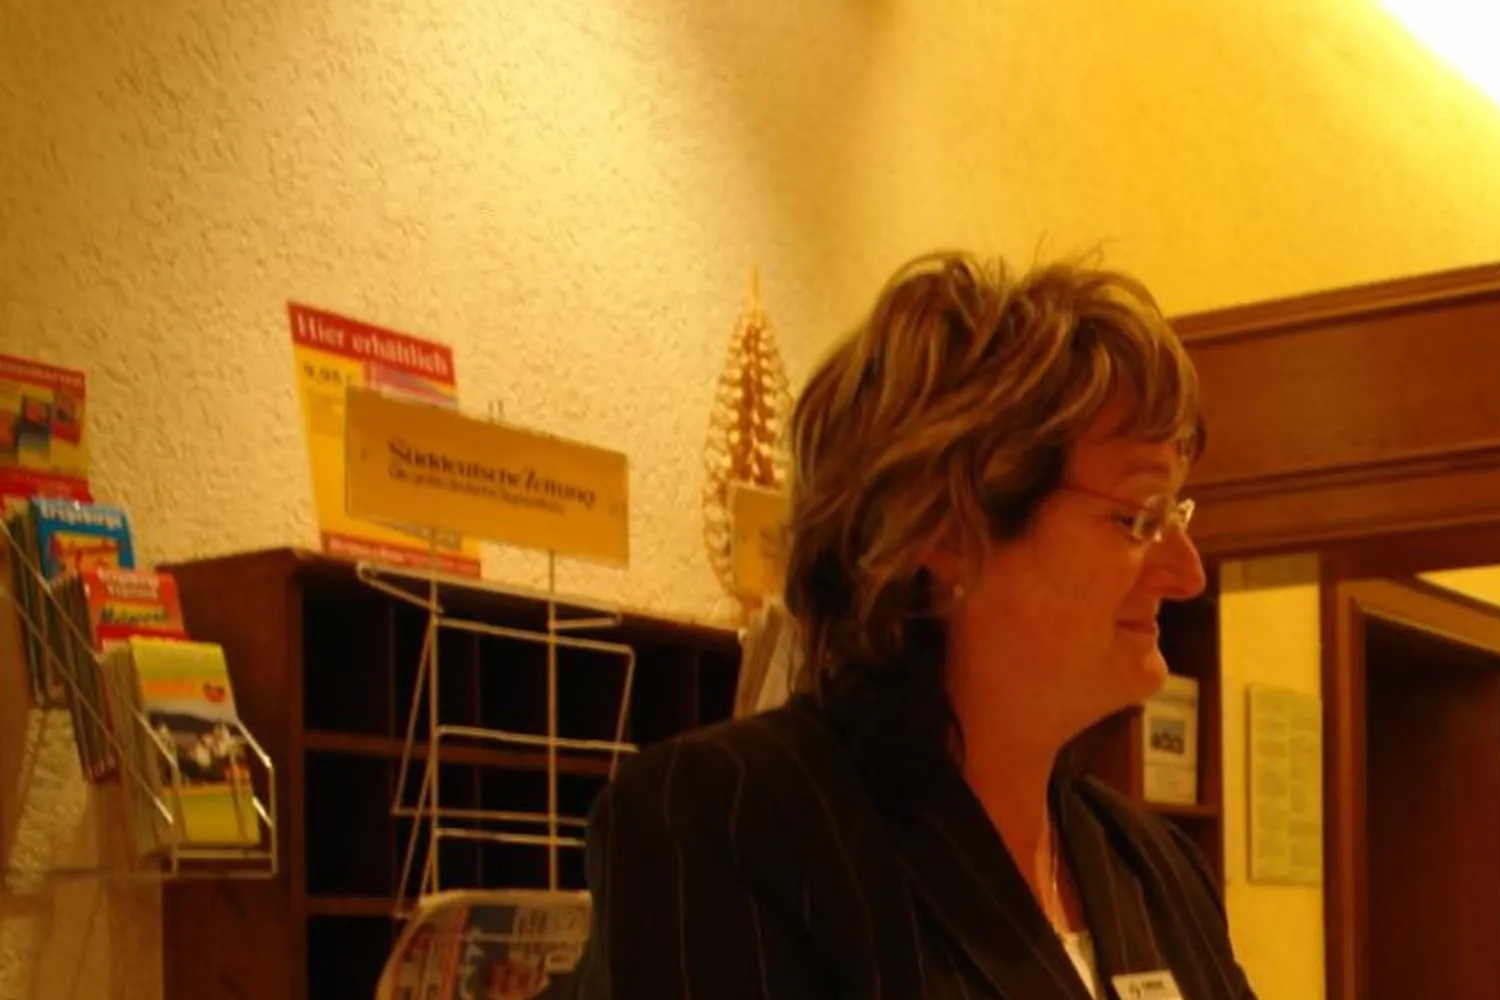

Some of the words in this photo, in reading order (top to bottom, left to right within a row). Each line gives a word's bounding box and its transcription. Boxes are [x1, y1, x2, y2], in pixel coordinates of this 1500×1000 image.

[297, 312, 345, 348] Hier
[351, 332, 449, 377] erhältlich
[525, 467, 595, 511] Zeitung
